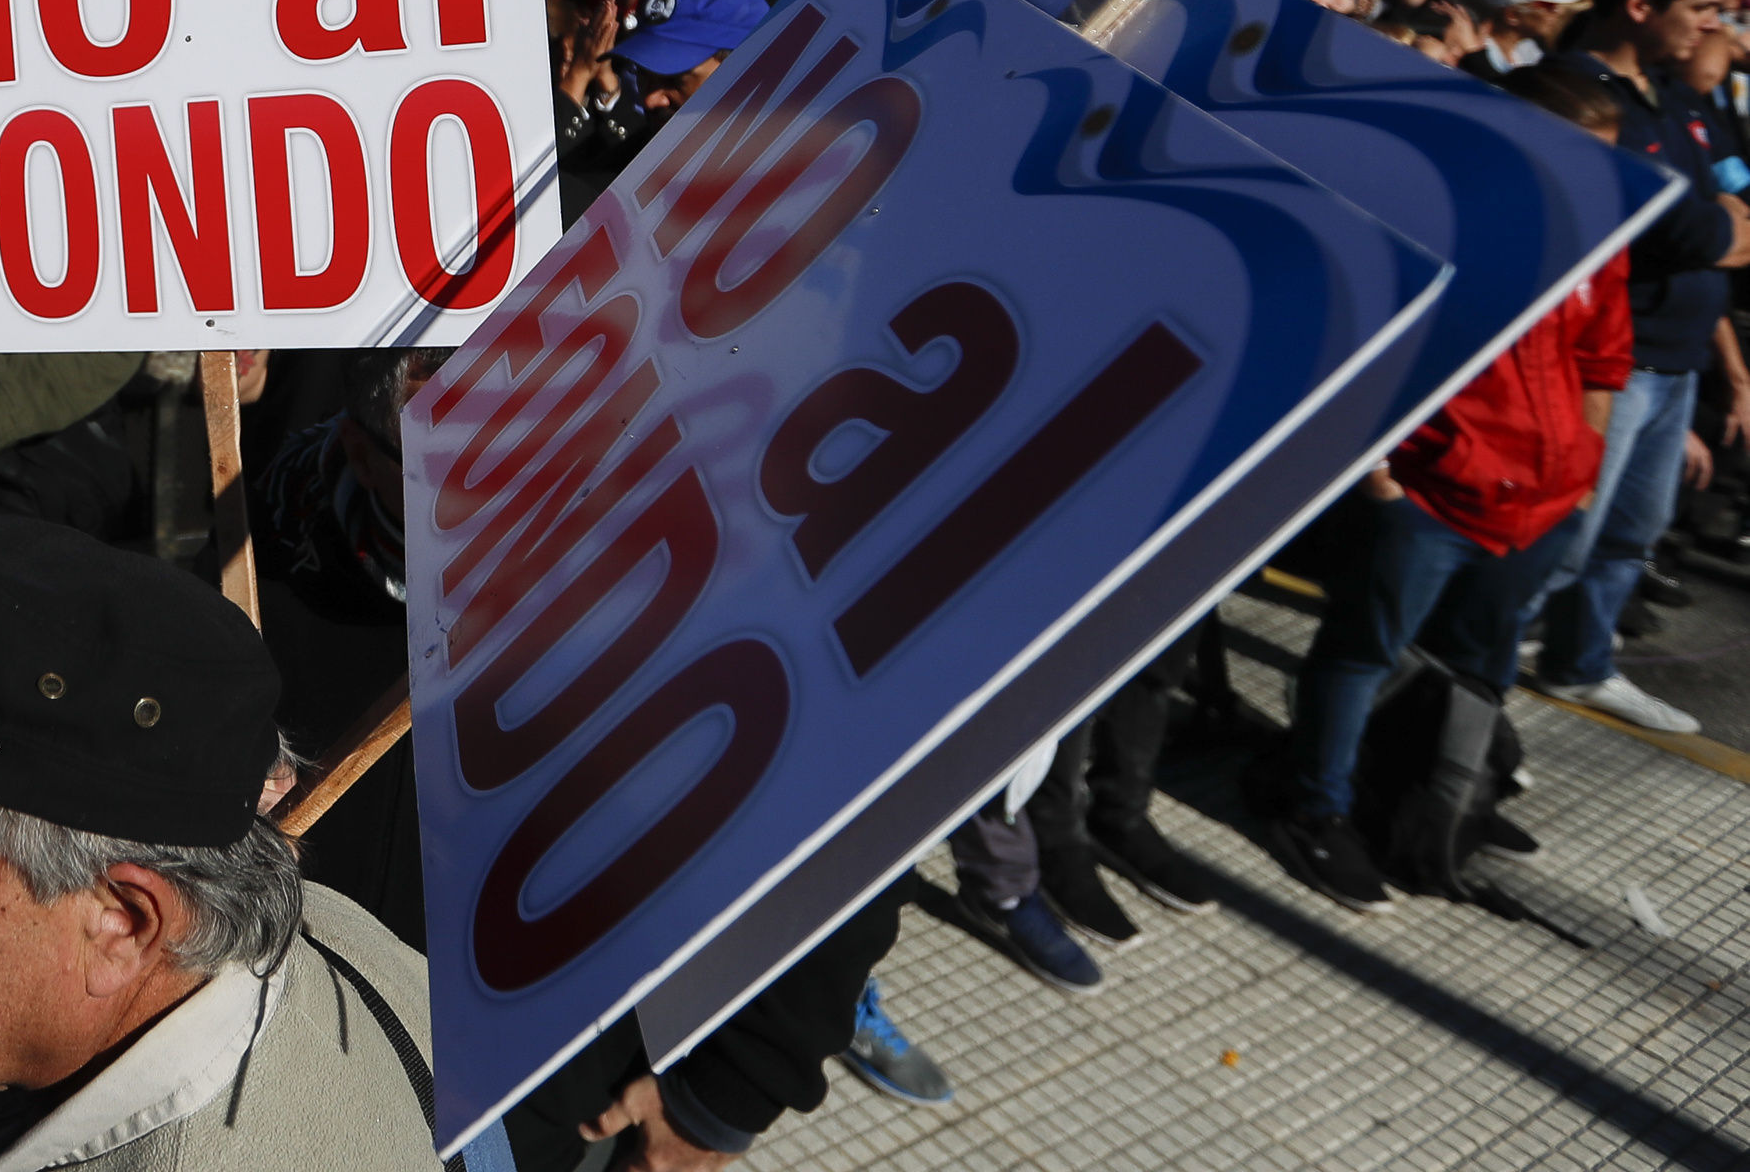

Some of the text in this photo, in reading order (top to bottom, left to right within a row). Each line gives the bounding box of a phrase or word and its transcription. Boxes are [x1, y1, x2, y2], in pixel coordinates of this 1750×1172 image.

[430, 224, 790, 993] FONDO
[634, 4, 1203, 679] NO al
